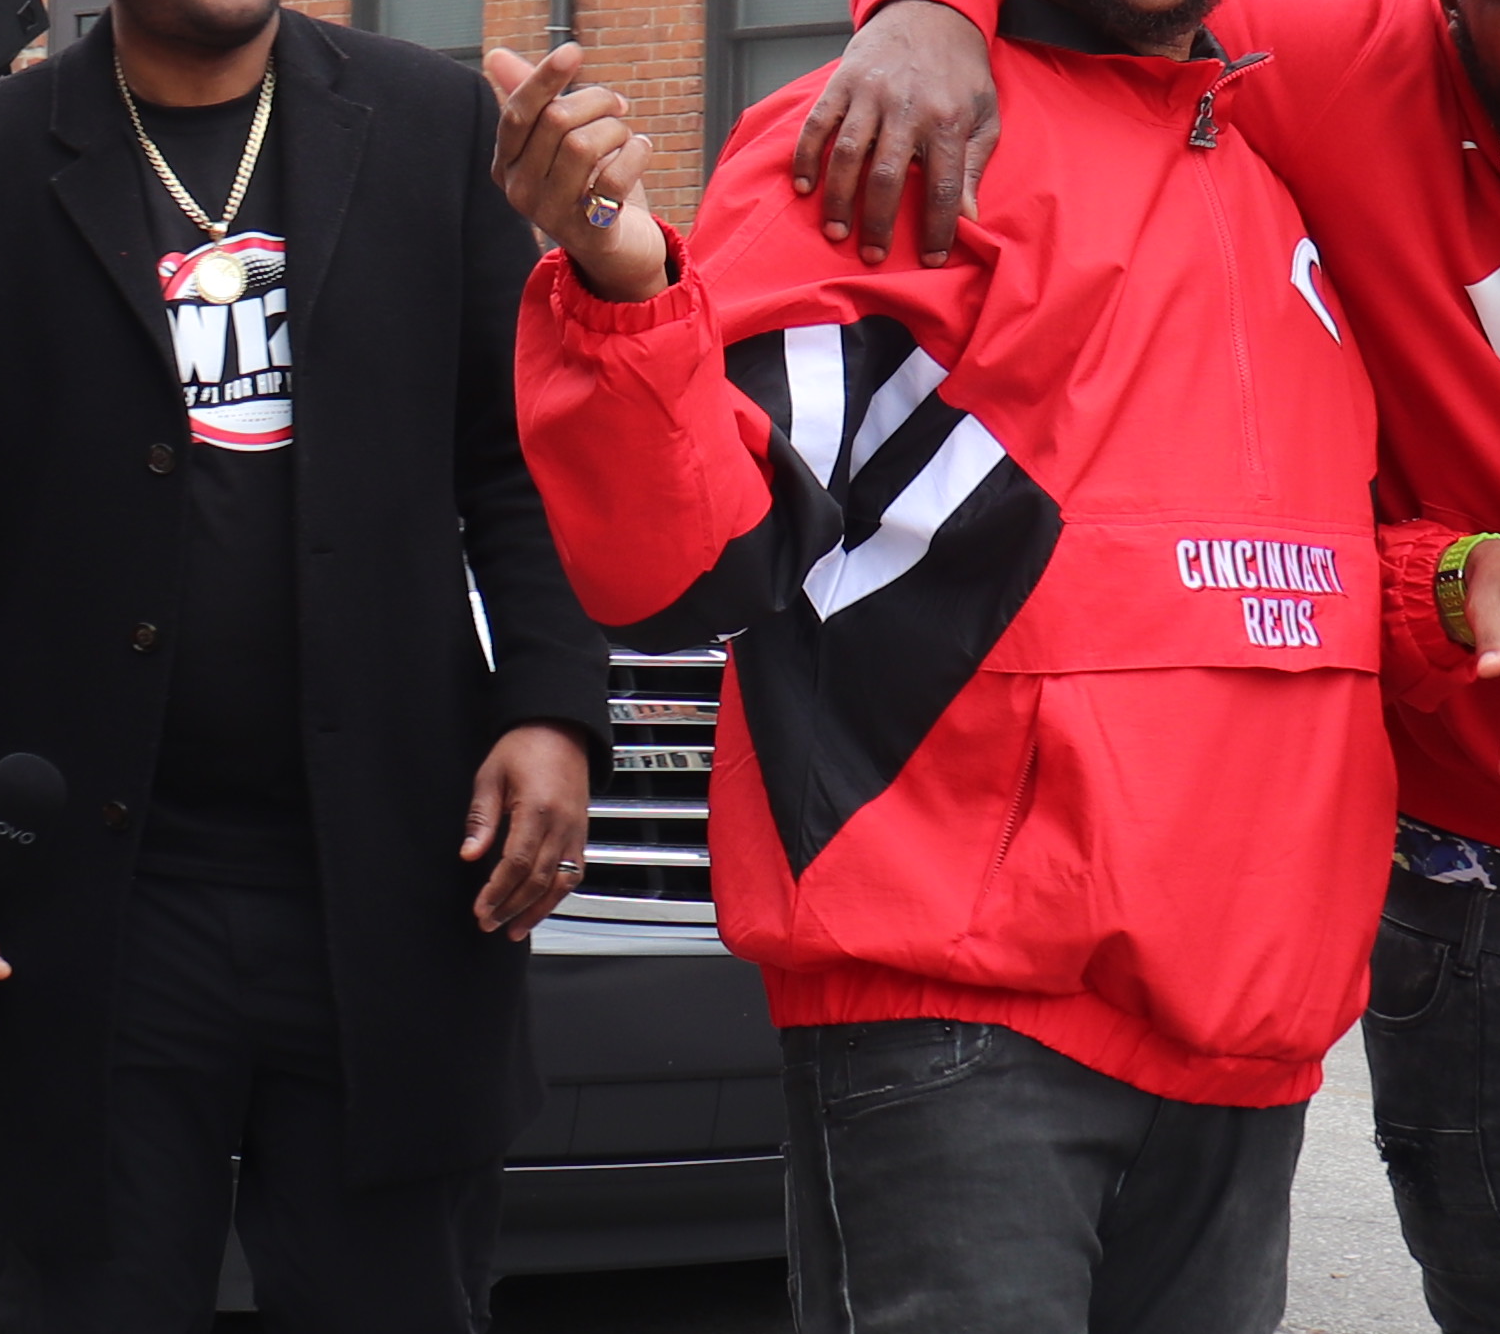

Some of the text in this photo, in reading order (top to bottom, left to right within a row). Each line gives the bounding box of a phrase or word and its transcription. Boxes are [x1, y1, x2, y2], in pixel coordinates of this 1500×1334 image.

[224, 377, 254, 402] FOR
[1176, 539, 1344, 592] CINCINNATI
[1240, 596, 1322, 648] REDS
